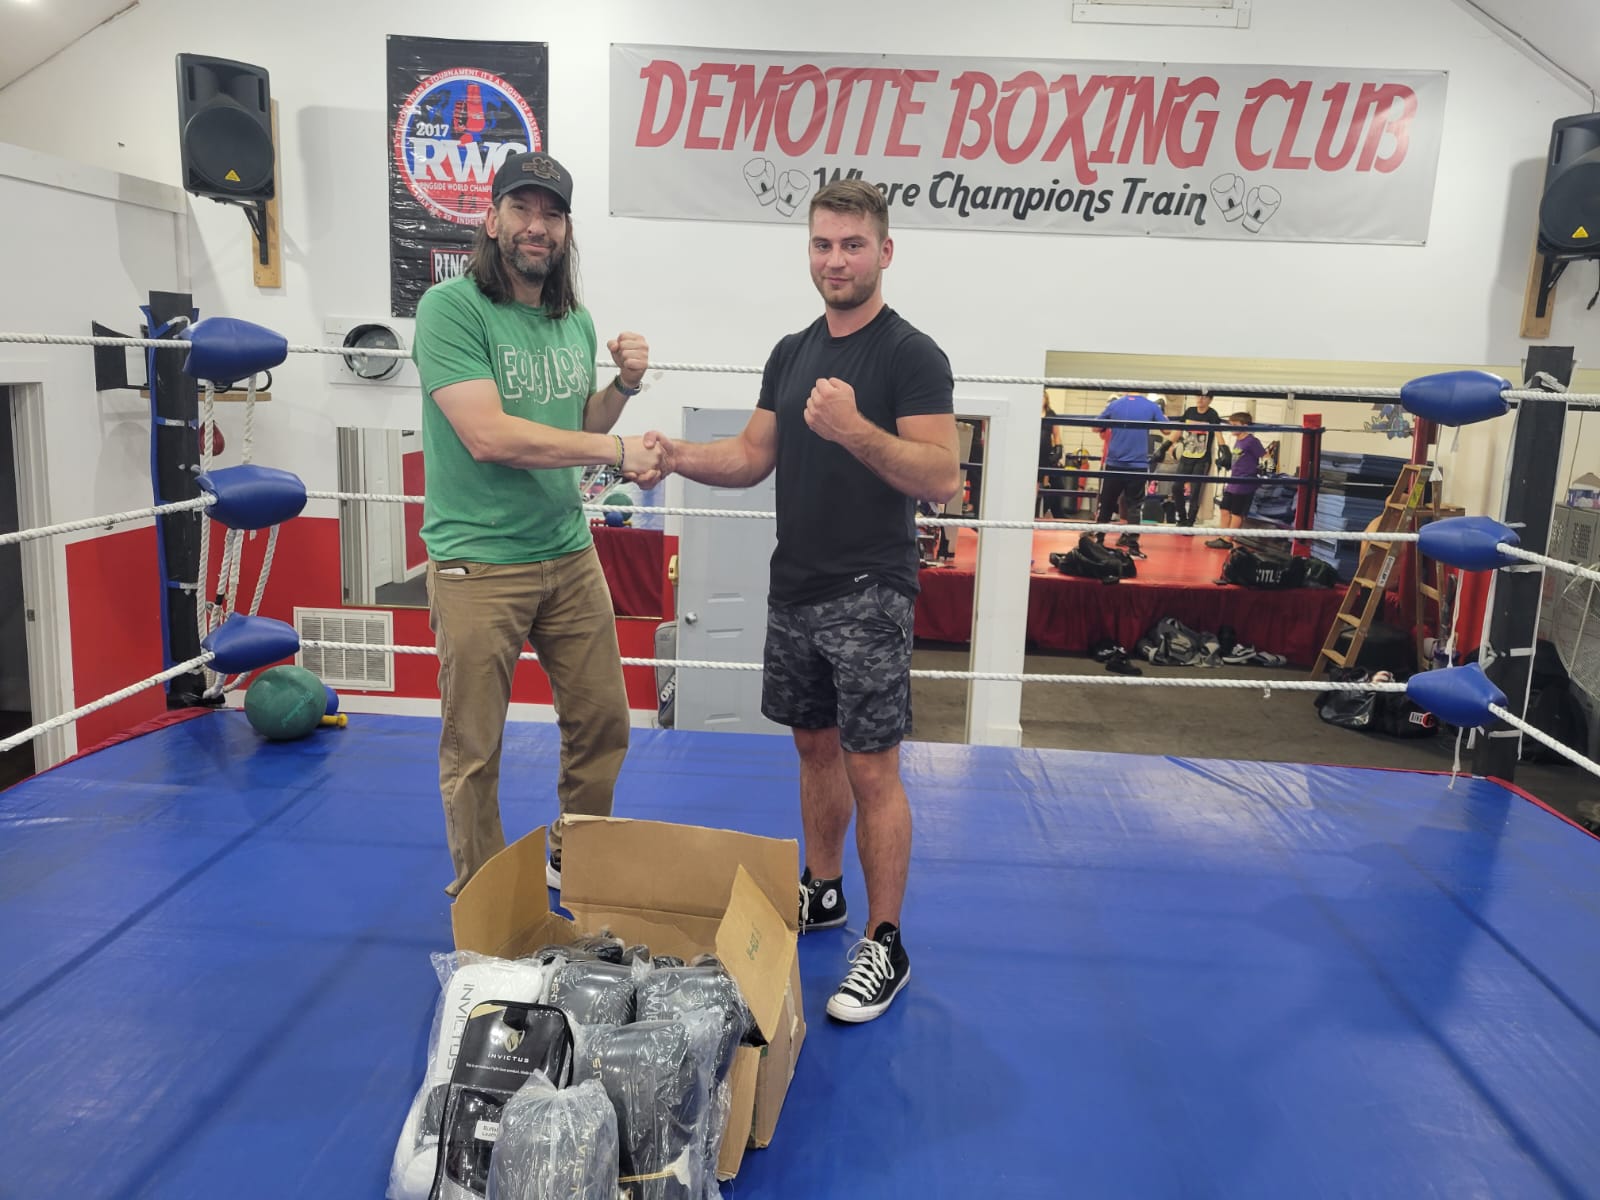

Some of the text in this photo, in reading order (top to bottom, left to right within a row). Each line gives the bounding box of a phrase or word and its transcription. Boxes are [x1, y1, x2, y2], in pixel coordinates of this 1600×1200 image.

[416, 121, 449, 137] 2017
[525, 110, 541, 147] PASSAGE
[635, 60, 1418, 185] DEMOTTE BOXING CLUB
[929, 171, 1113, 222] Champions
[1121, 177, 1206, 225] Train
[488, 1052, 529, 1063] INVICTUS
